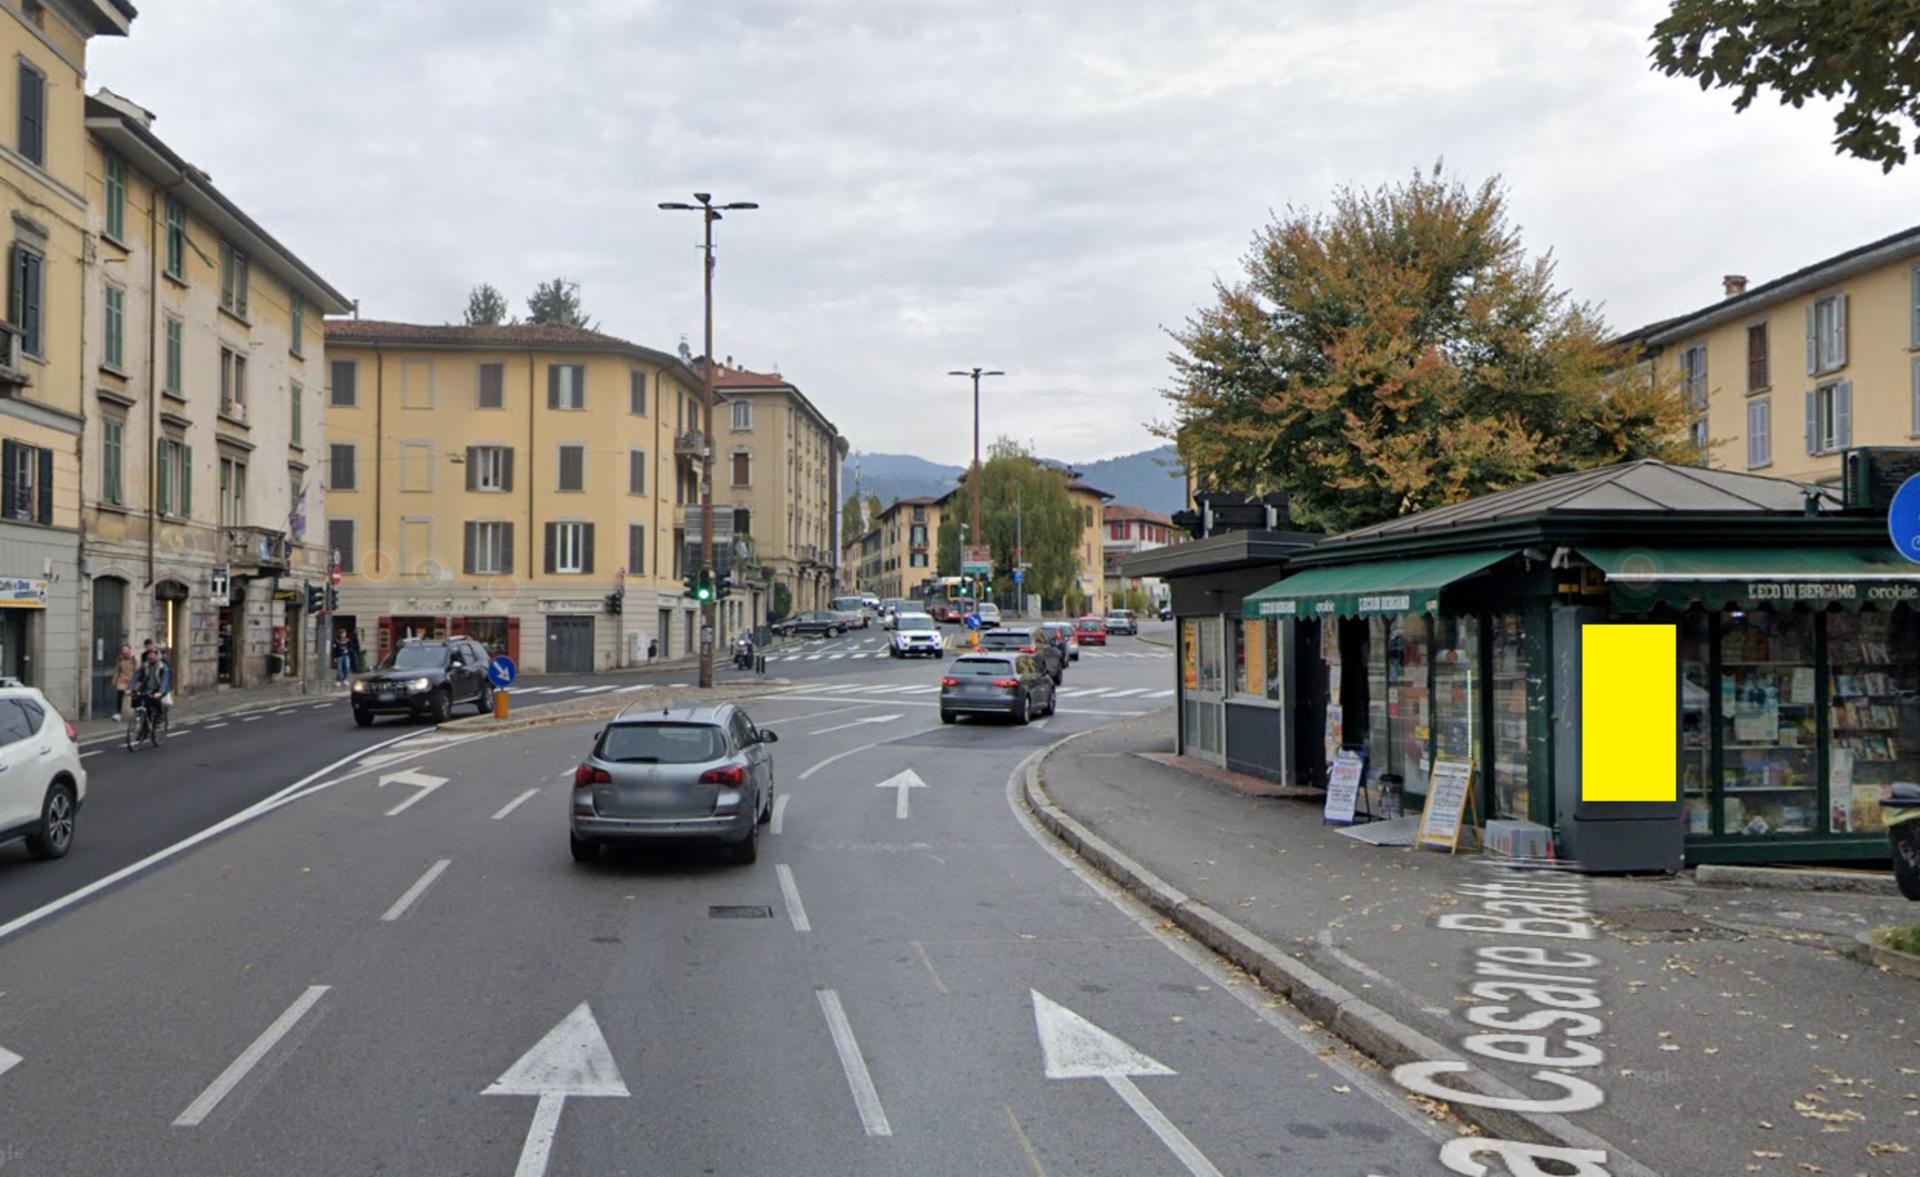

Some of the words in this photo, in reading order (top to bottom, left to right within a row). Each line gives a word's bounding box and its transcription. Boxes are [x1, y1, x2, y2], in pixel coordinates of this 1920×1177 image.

[1783, 584, 1796, 600] DI
[1798, 584, 1857, 600] BERGAMO
[1868, 584, 1918, 601] orobie
